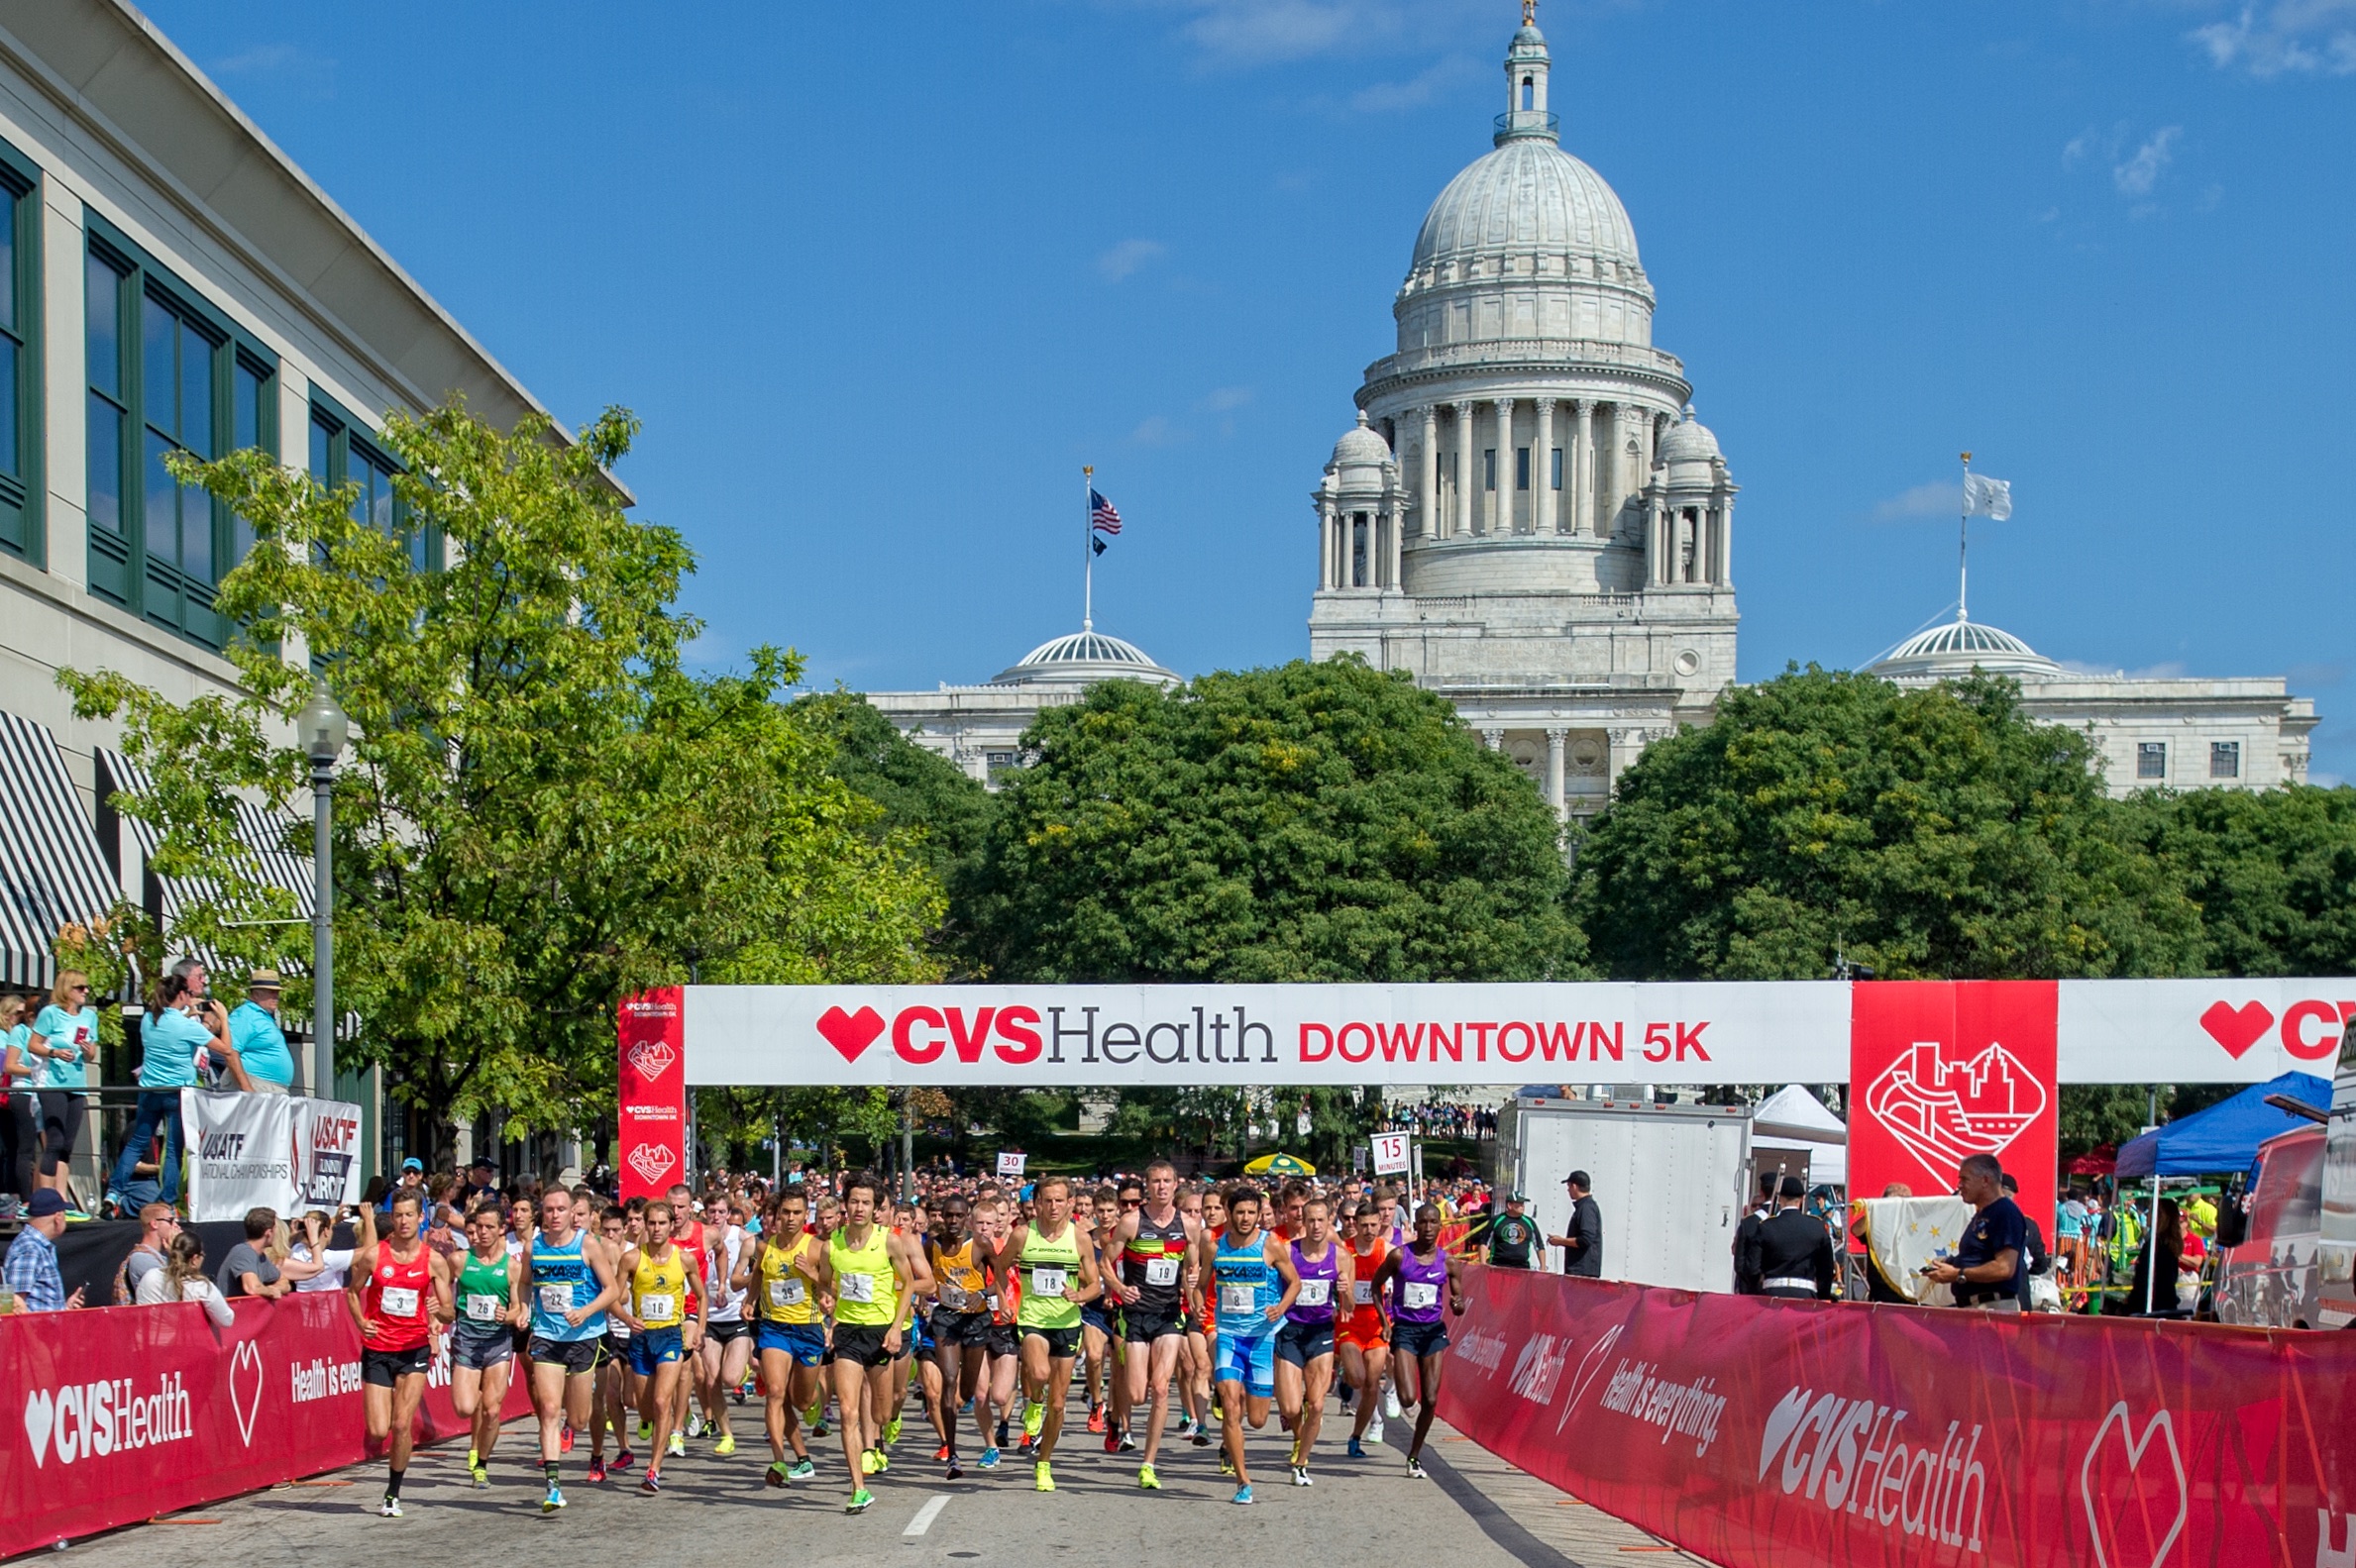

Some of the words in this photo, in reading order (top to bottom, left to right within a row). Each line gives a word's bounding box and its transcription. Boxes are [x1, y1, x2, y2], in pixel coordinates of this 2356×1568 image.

[1299, 1021, 1625, 1063] DOWNTOWN
[1643, 1021, 1712, 1063] 5K
[314, 1115, 358, 1151] USATF
[203, 1133, 246, 1160] USATF
[1382, 1138, 1401, 1158] 15
[1004, 1156, 1018, 1167] 30
[1378, 1161, 1406, 1172] MINUTES
[1159, 1267, 1170, 1279] 19
[1044, 1278, 1056, 1290] 18
[551, 1294, 563, 1306] 22
[781, 1288, 794, 1300] 39
[948, 1294, 959, 1304] 12
[1418, 1292, 1425, 1304] 5
[397, 1297, 403, 1308] 3
[1233, 1296, 1240, 1307] 8
[478, 1303, 489, 1314] 26
[290, 1358, 328, 1404] Health
[327, 1356, 339, 1397] is
[339, 1361, 363, 1393] ever
[1631, 1363, 1659, 1418] is
